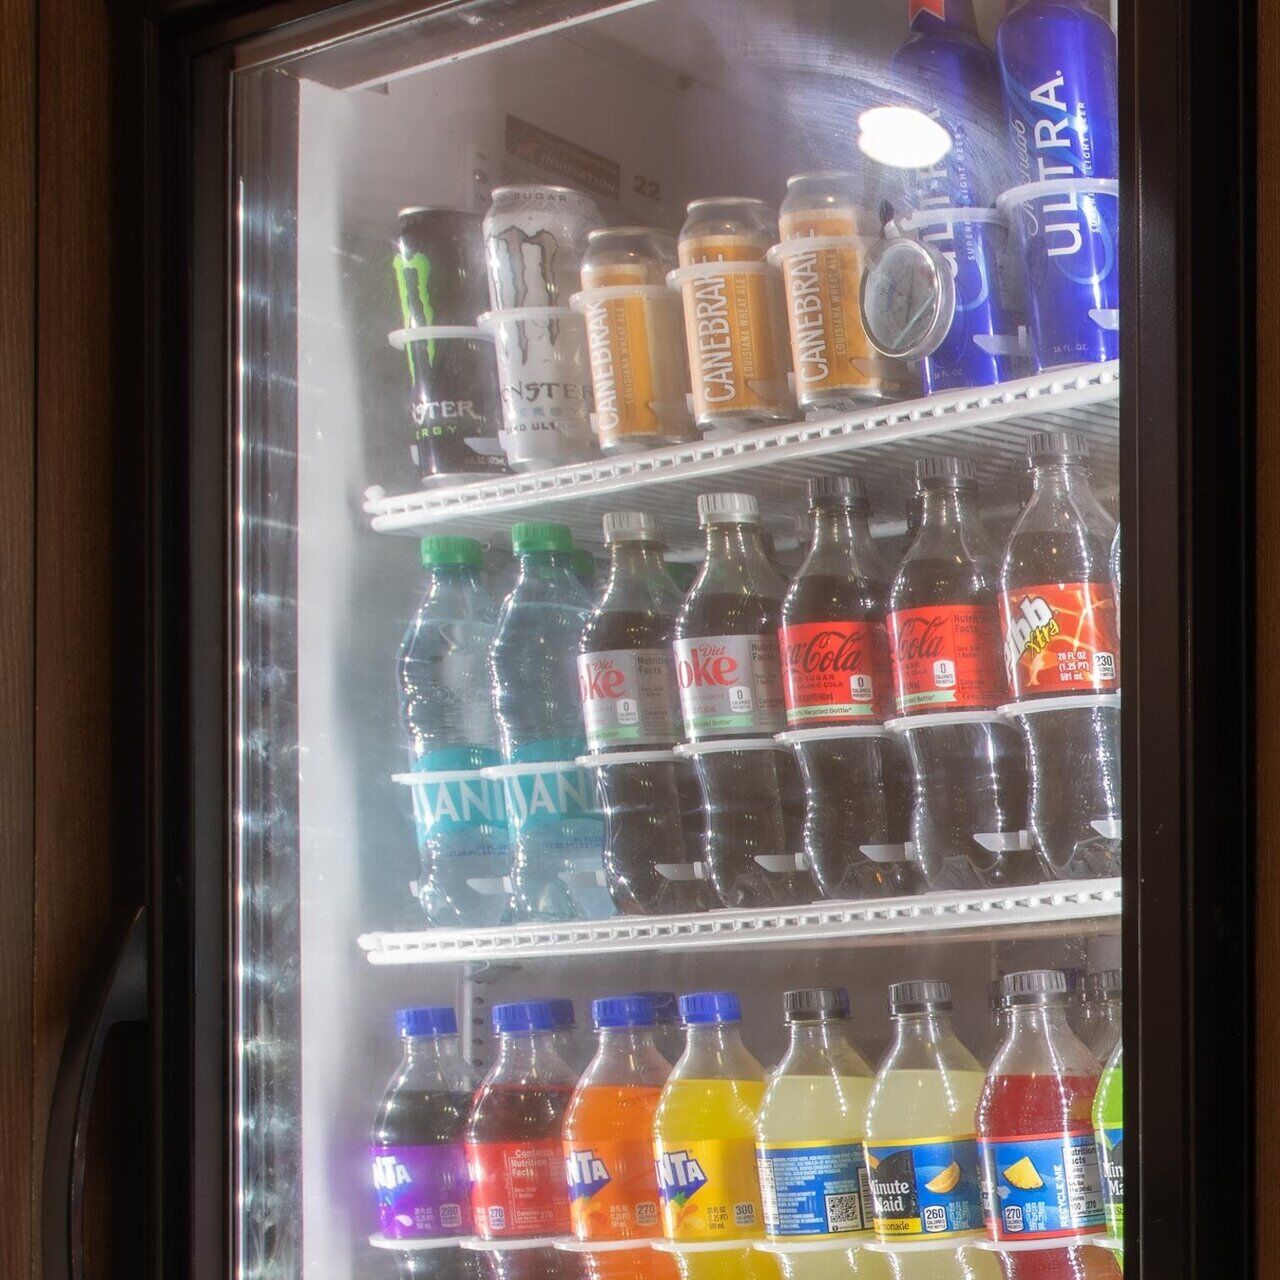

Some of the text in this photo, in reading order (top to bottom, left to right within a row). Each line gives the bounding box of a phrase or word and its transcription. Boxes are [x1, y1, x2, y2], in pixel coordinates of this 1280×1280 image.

[1030, 70, 1083, 257] ULTRA
[926, 1208, 945, 1220] 260
[1006, 1208, 1021, 1219] 270
[1056, 1188, 1067, 1227] RECYCLE
